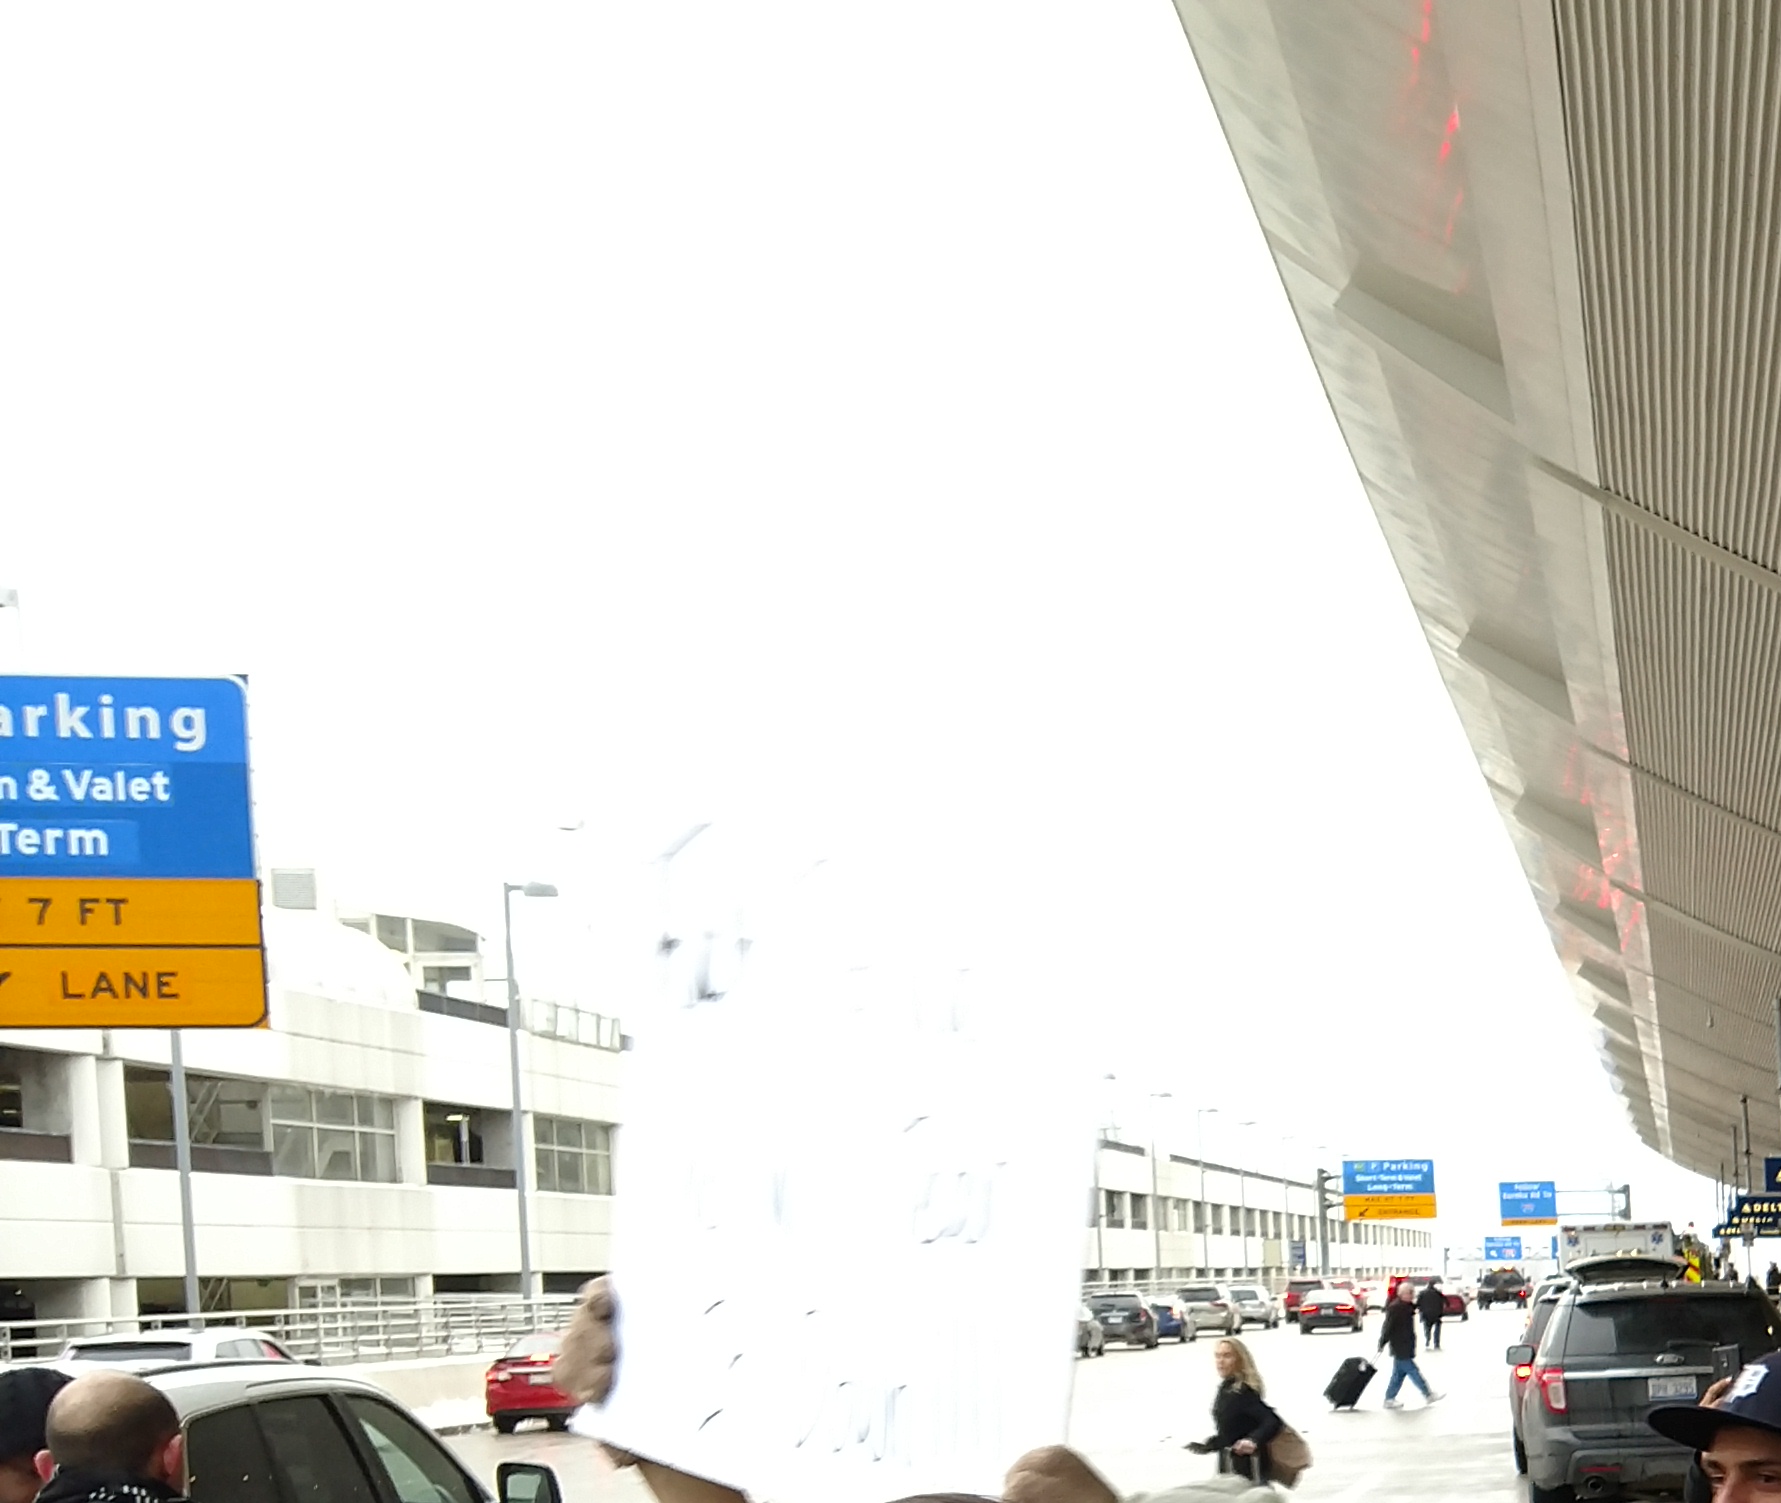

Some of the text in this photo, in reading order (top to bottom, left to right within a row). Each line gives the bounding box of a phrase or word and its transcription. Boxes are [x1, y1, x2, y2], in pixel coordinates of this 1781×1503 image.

[26, 768, 60, 802] &
[62, 769, 171, 802] Valet
[0, 823, 110, 857] Term
[28, 897, 129, 926] 7 FT
[60, 970, 181, 1000] LANE
